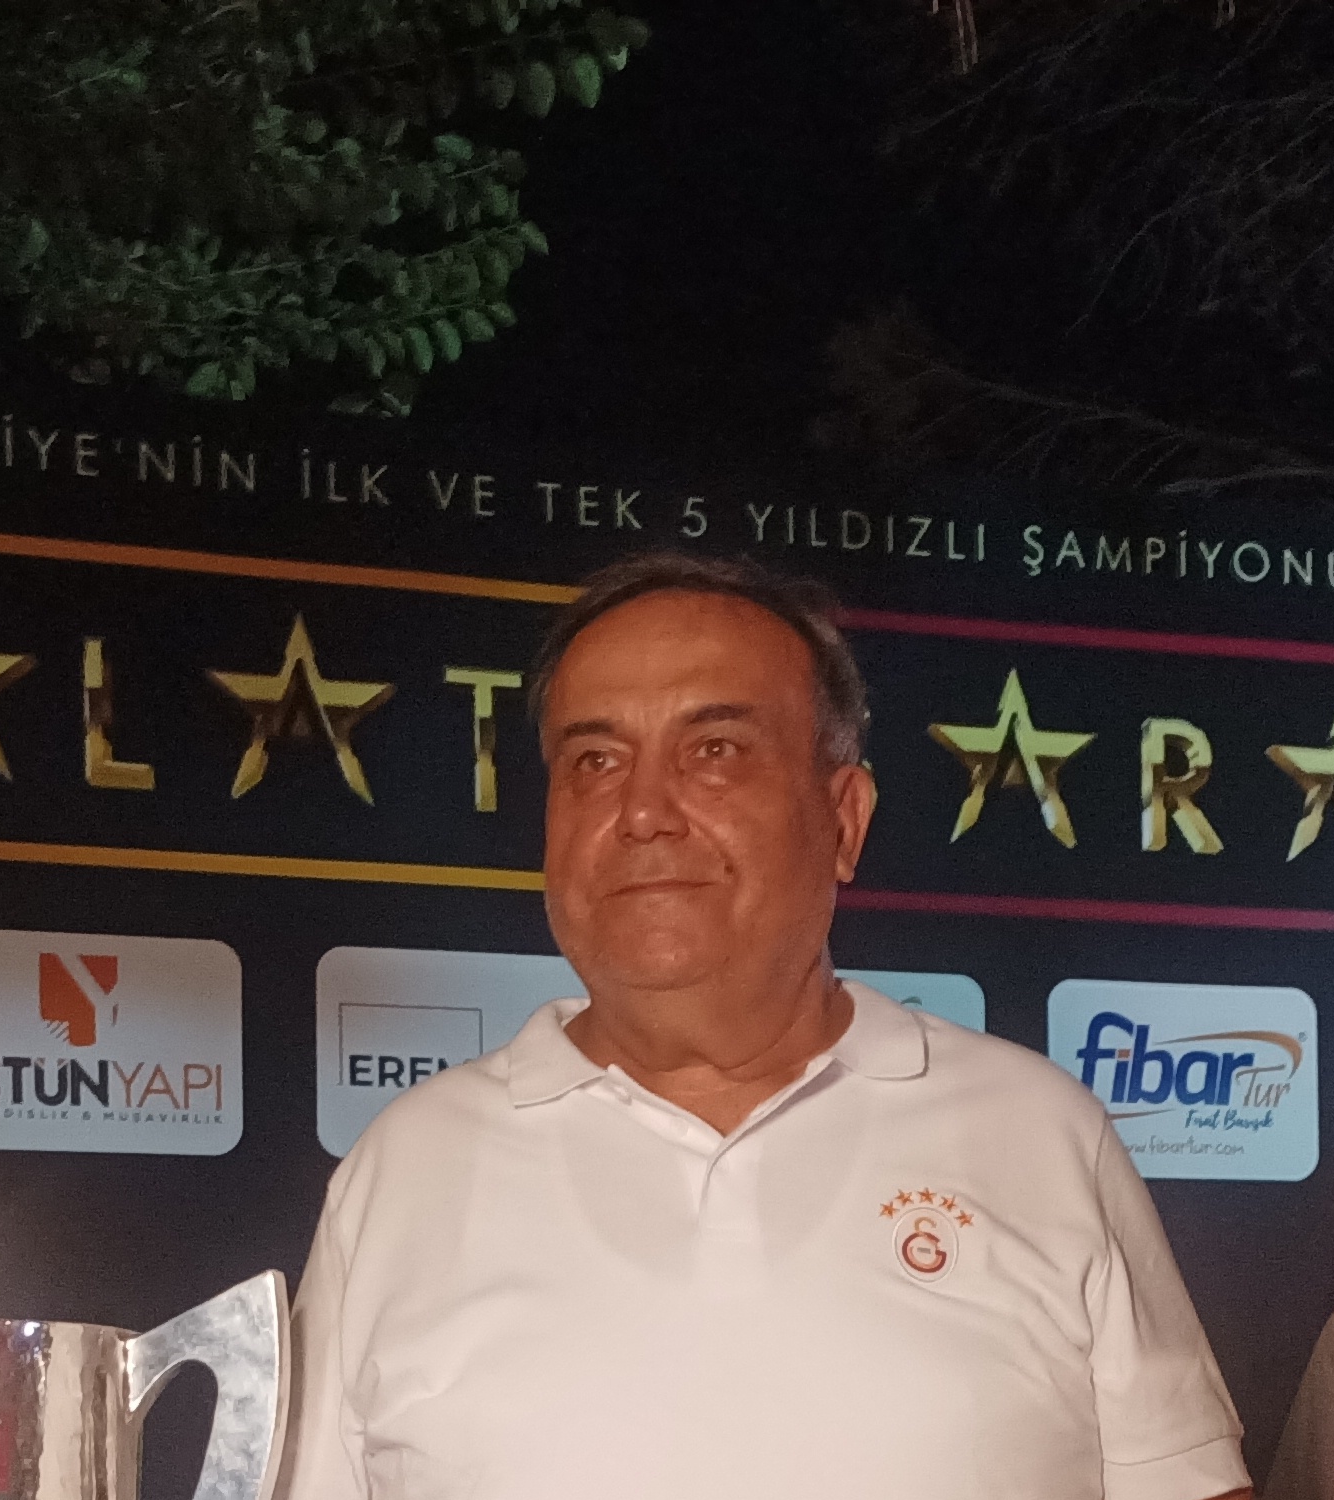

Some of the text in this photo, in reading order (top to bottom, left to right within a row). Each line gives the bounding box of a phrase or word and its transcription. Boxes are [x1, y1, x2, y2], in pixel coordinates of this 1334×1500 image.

[300, 447, 392, 506] İLK
[428, 469, 497, 518] VE
[536, 479, 642, 531] TEK
[681, 496, 709, 539] 5
[746, 501, 986, 563] YILDIZLI
[1075, 1011, 1255, 1107] fibar
